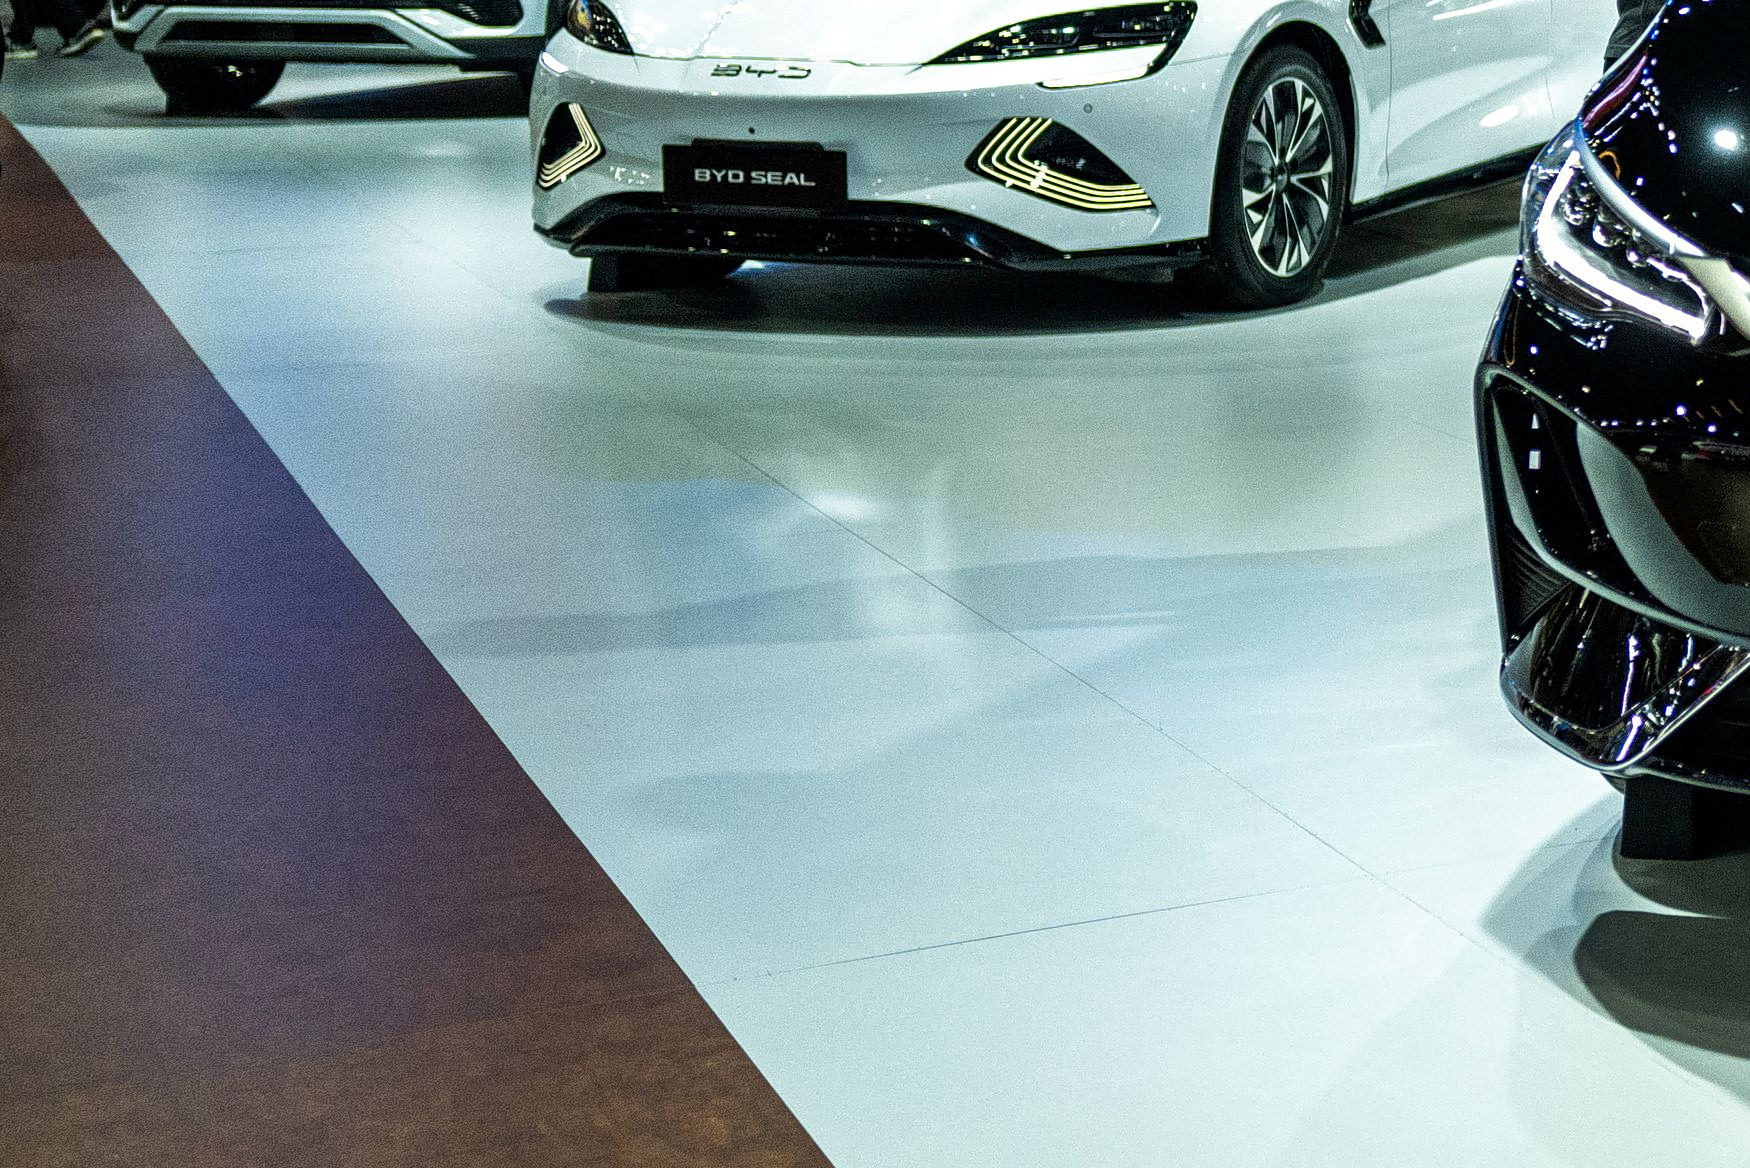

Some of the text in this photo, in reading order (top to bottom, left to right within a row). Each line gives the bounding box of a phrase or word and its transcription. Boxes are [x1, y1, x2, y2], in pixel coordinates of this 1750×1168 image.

[711, 64, 811, 79] BYD
[694, 168, 816, 187] BYD SEAL
